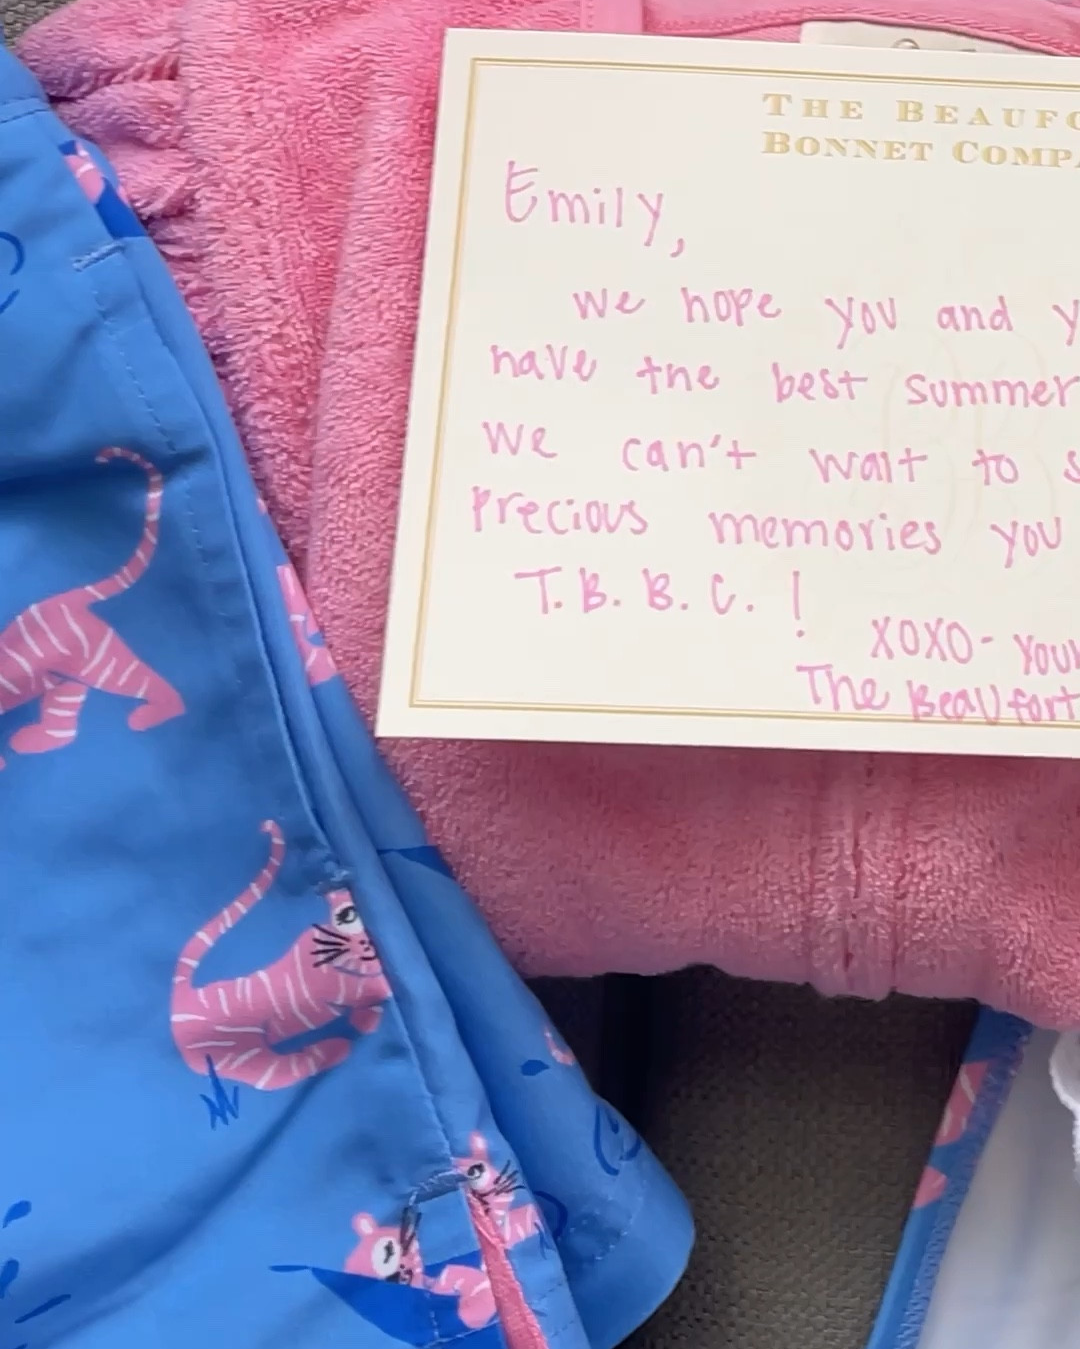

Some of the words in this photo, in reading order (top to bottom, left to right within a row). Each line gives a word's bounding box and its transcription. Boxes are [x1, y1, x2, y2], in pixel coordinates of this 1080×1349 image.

[763, 92, 863, 119] THE
[762, 130, 933, 162] BONNET
[503, 158, 686, 258] Emily,
[679, 286, 783, 328] hope
[823, 295, 898, 349] you
[935, 295, 1014, 332] and
[769, 361, 866, 404] best
[621, 434, 757, 471] can't
[971, 447, 1020, 486] to
[707, 511, 942, 556] memories
[989, 515, 1063, 569] you
[795, 663, 890, 713] The
